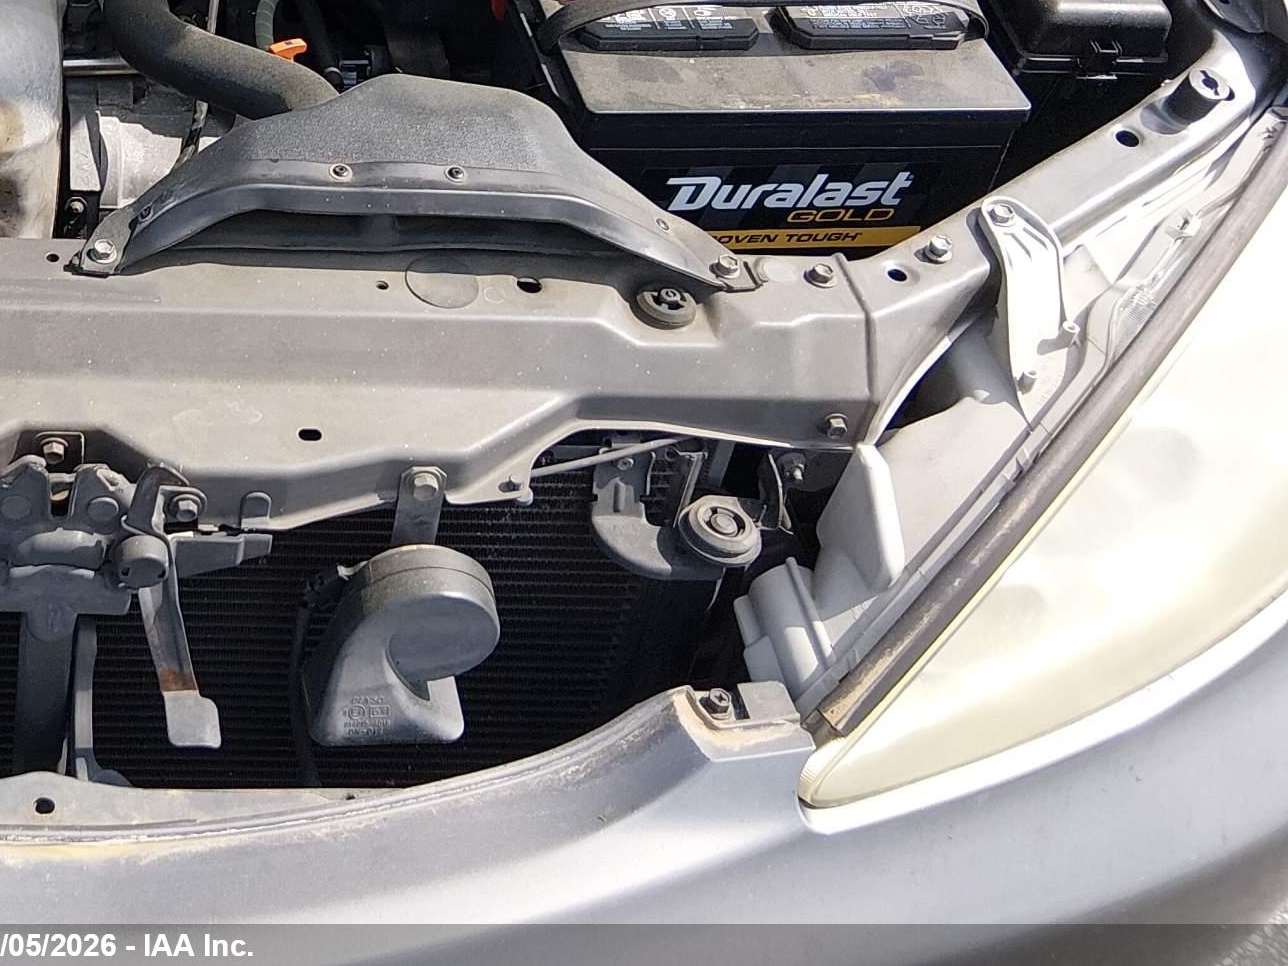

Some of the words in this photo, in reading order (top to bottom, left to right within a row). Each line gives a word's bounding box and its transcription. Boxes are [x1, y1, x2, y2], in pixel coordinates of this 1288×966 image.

[666, 171, 912, 211] Duralast
[786, 208, 895, 223] GOLD
[712, 234, 779, 244] OVEN
[785, 232, 859, 243] TOUGH
